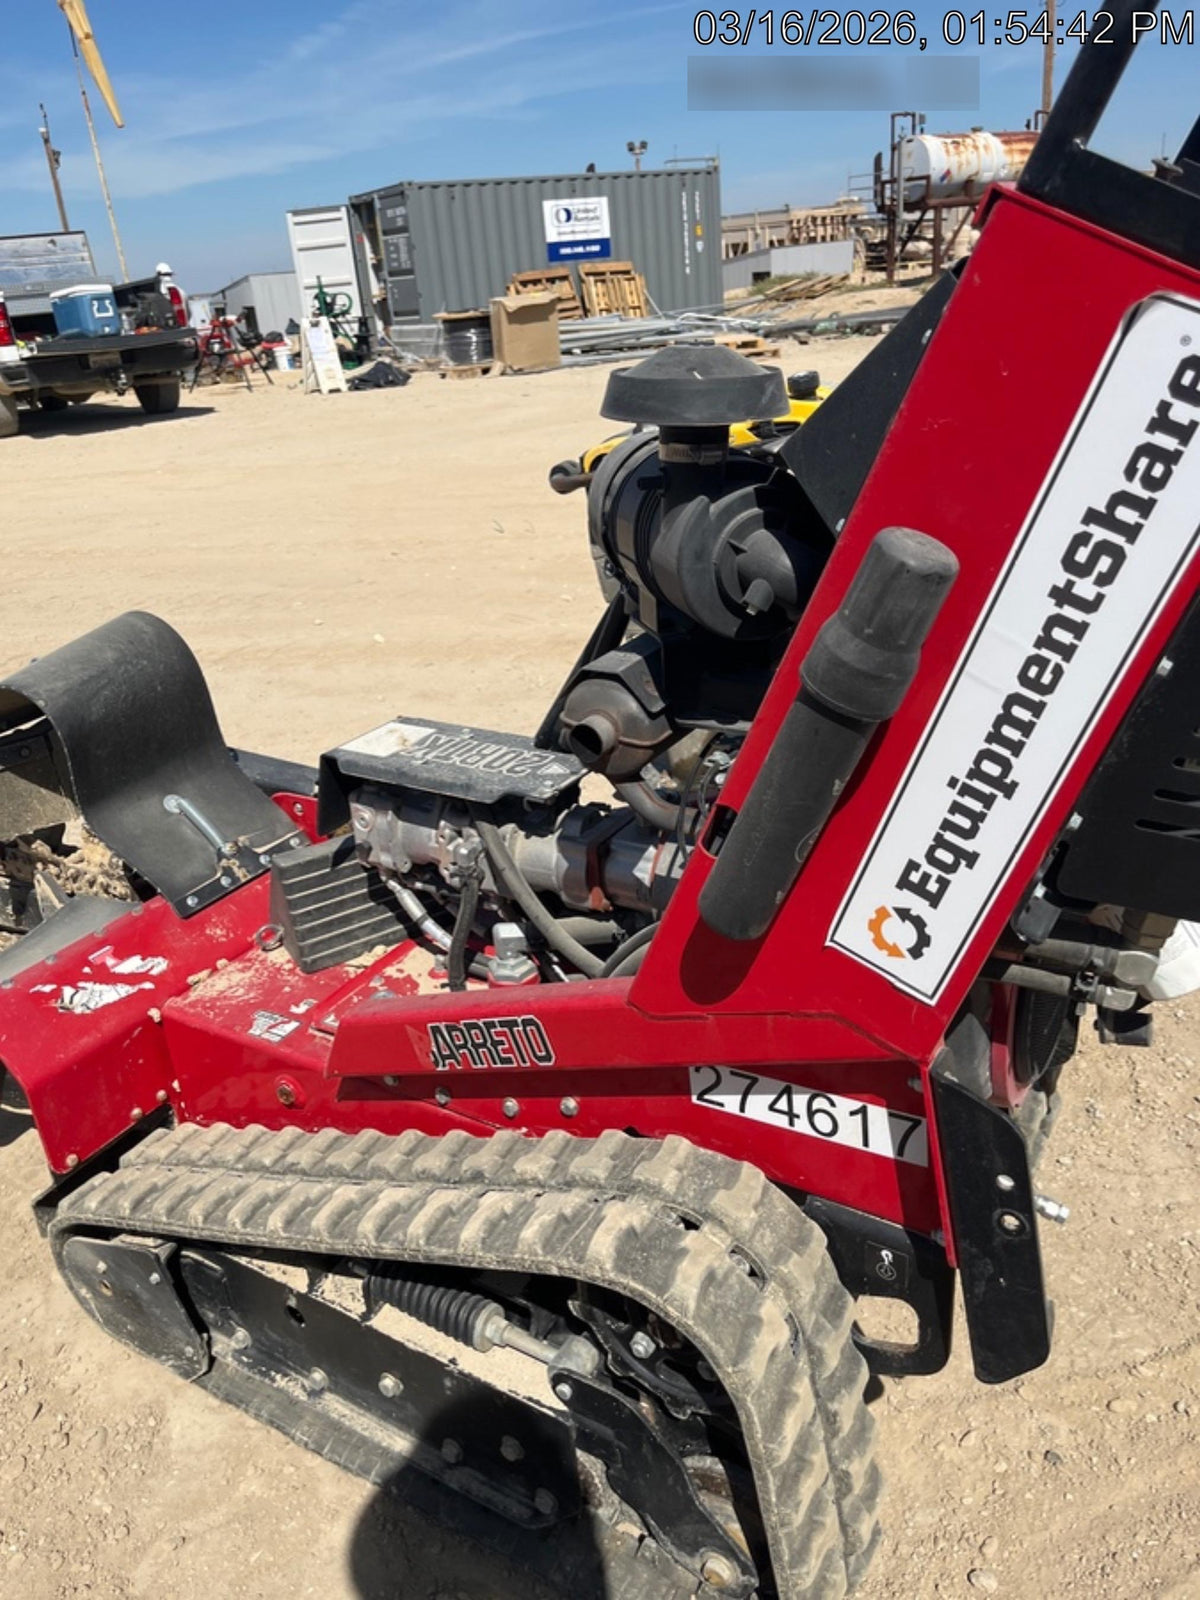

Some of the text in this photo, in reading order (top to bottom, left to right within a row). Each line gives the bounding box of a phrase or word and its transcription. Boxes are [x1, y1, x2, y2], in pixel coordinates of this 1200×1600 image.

[896, 353, 1200, 909] EquipmentShare
[427, 1014, 556, 1071] ARRETO
[693, 1065, 922, 1157] 274617
